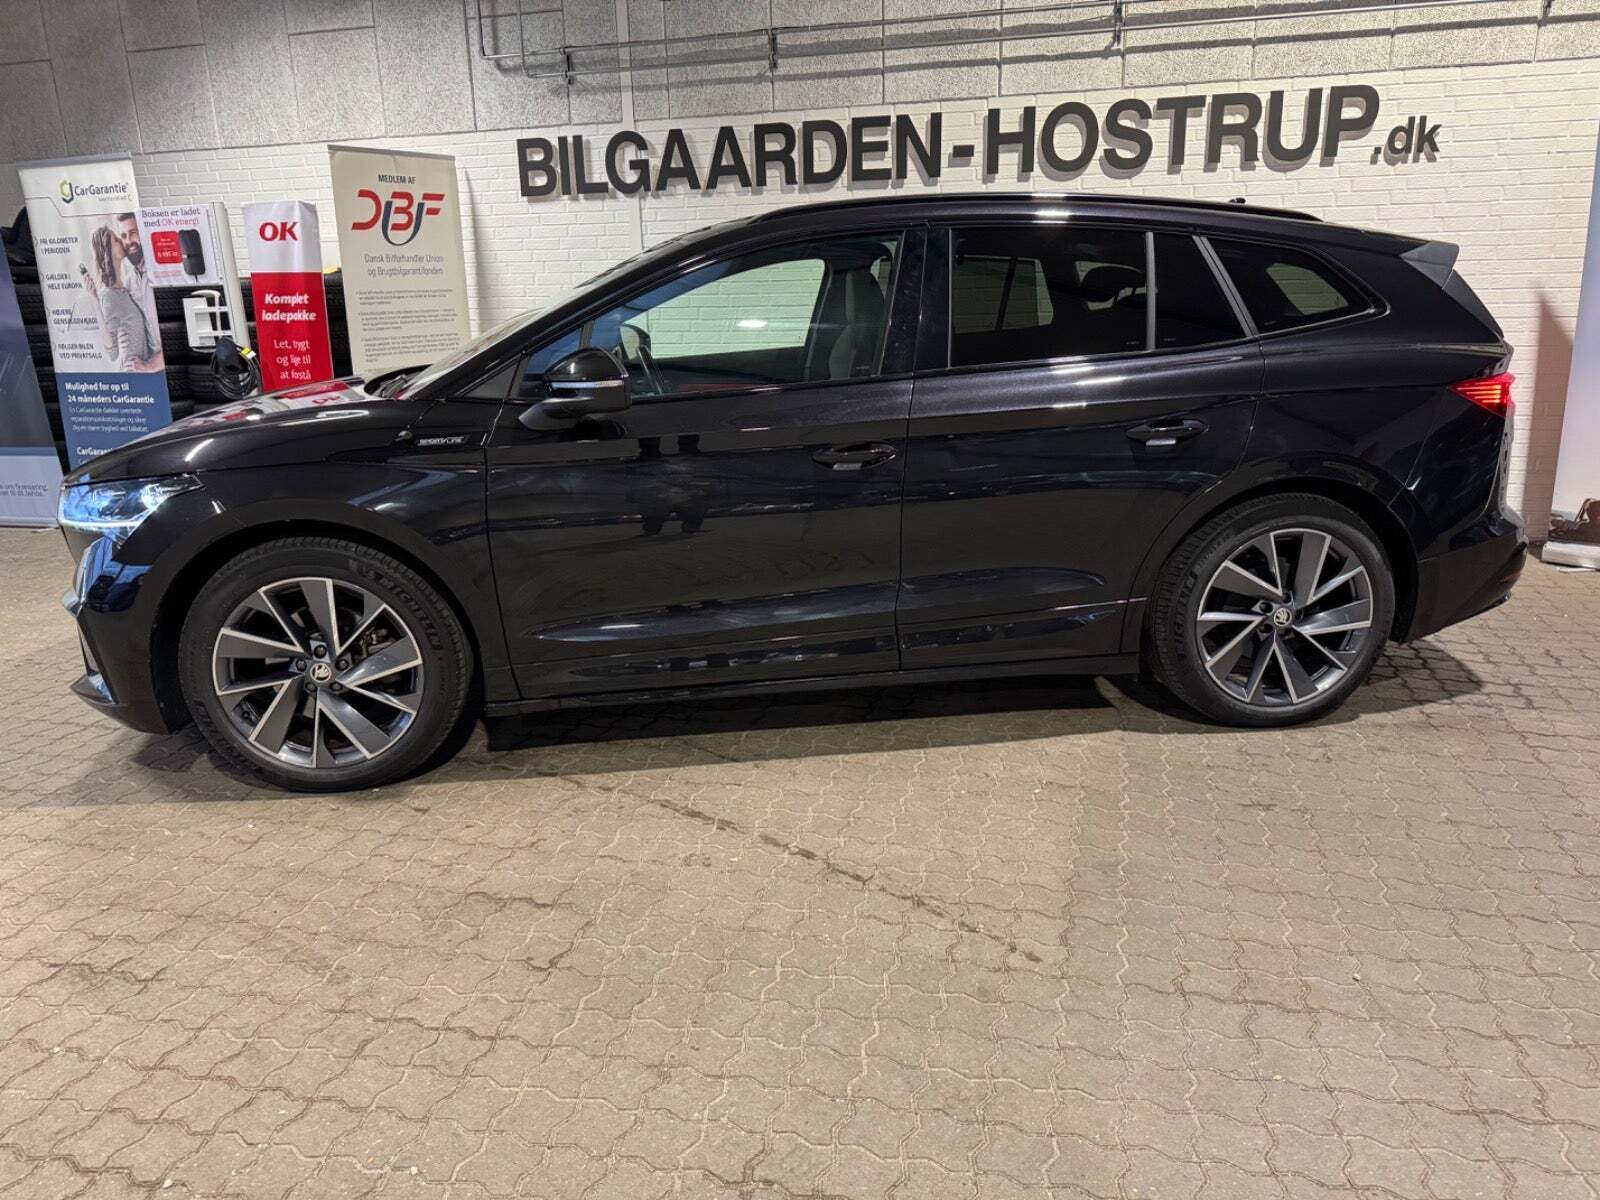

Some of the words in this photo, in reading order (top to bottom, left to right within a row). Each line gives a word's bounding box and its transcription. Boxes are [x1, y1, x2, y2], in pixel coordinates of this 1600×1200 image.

[517, 84, 1441, 197] BILGAARDEN-HOSTRUP.dk
[378, 174, 407, 184] MEDLEM
[74, 182, 127, 196] CarGarantie
[141, 209, 170, 218] Boksen
[180, 207, 201, 216] ladet
[143, 219, 161, 227] med
[161, 218, 174, 226] OK
[175, 218, 199, 227] energi
[259, 221, 299, 242] OK
[48, 236, 78, 244] KILOMETER
[364, 253, 384, 263] Dansk
[425, 254, 444, 263] Union
[367, 268, 376, 278] og
[275, 355, 289, 367] og
[302, 354, 311, 364] til
[280, 371, 290, 380] at
[65, 382, 98, 392] Mulighed
[99, 382, 109, 391] for
[110, 384, 120, 392] op
[121, 382, 129, 391] til
[67, 394, 77, 403] 24
[77, 394, 112, 403] måneders
[112, 394, 155, 404] CarGarantie
